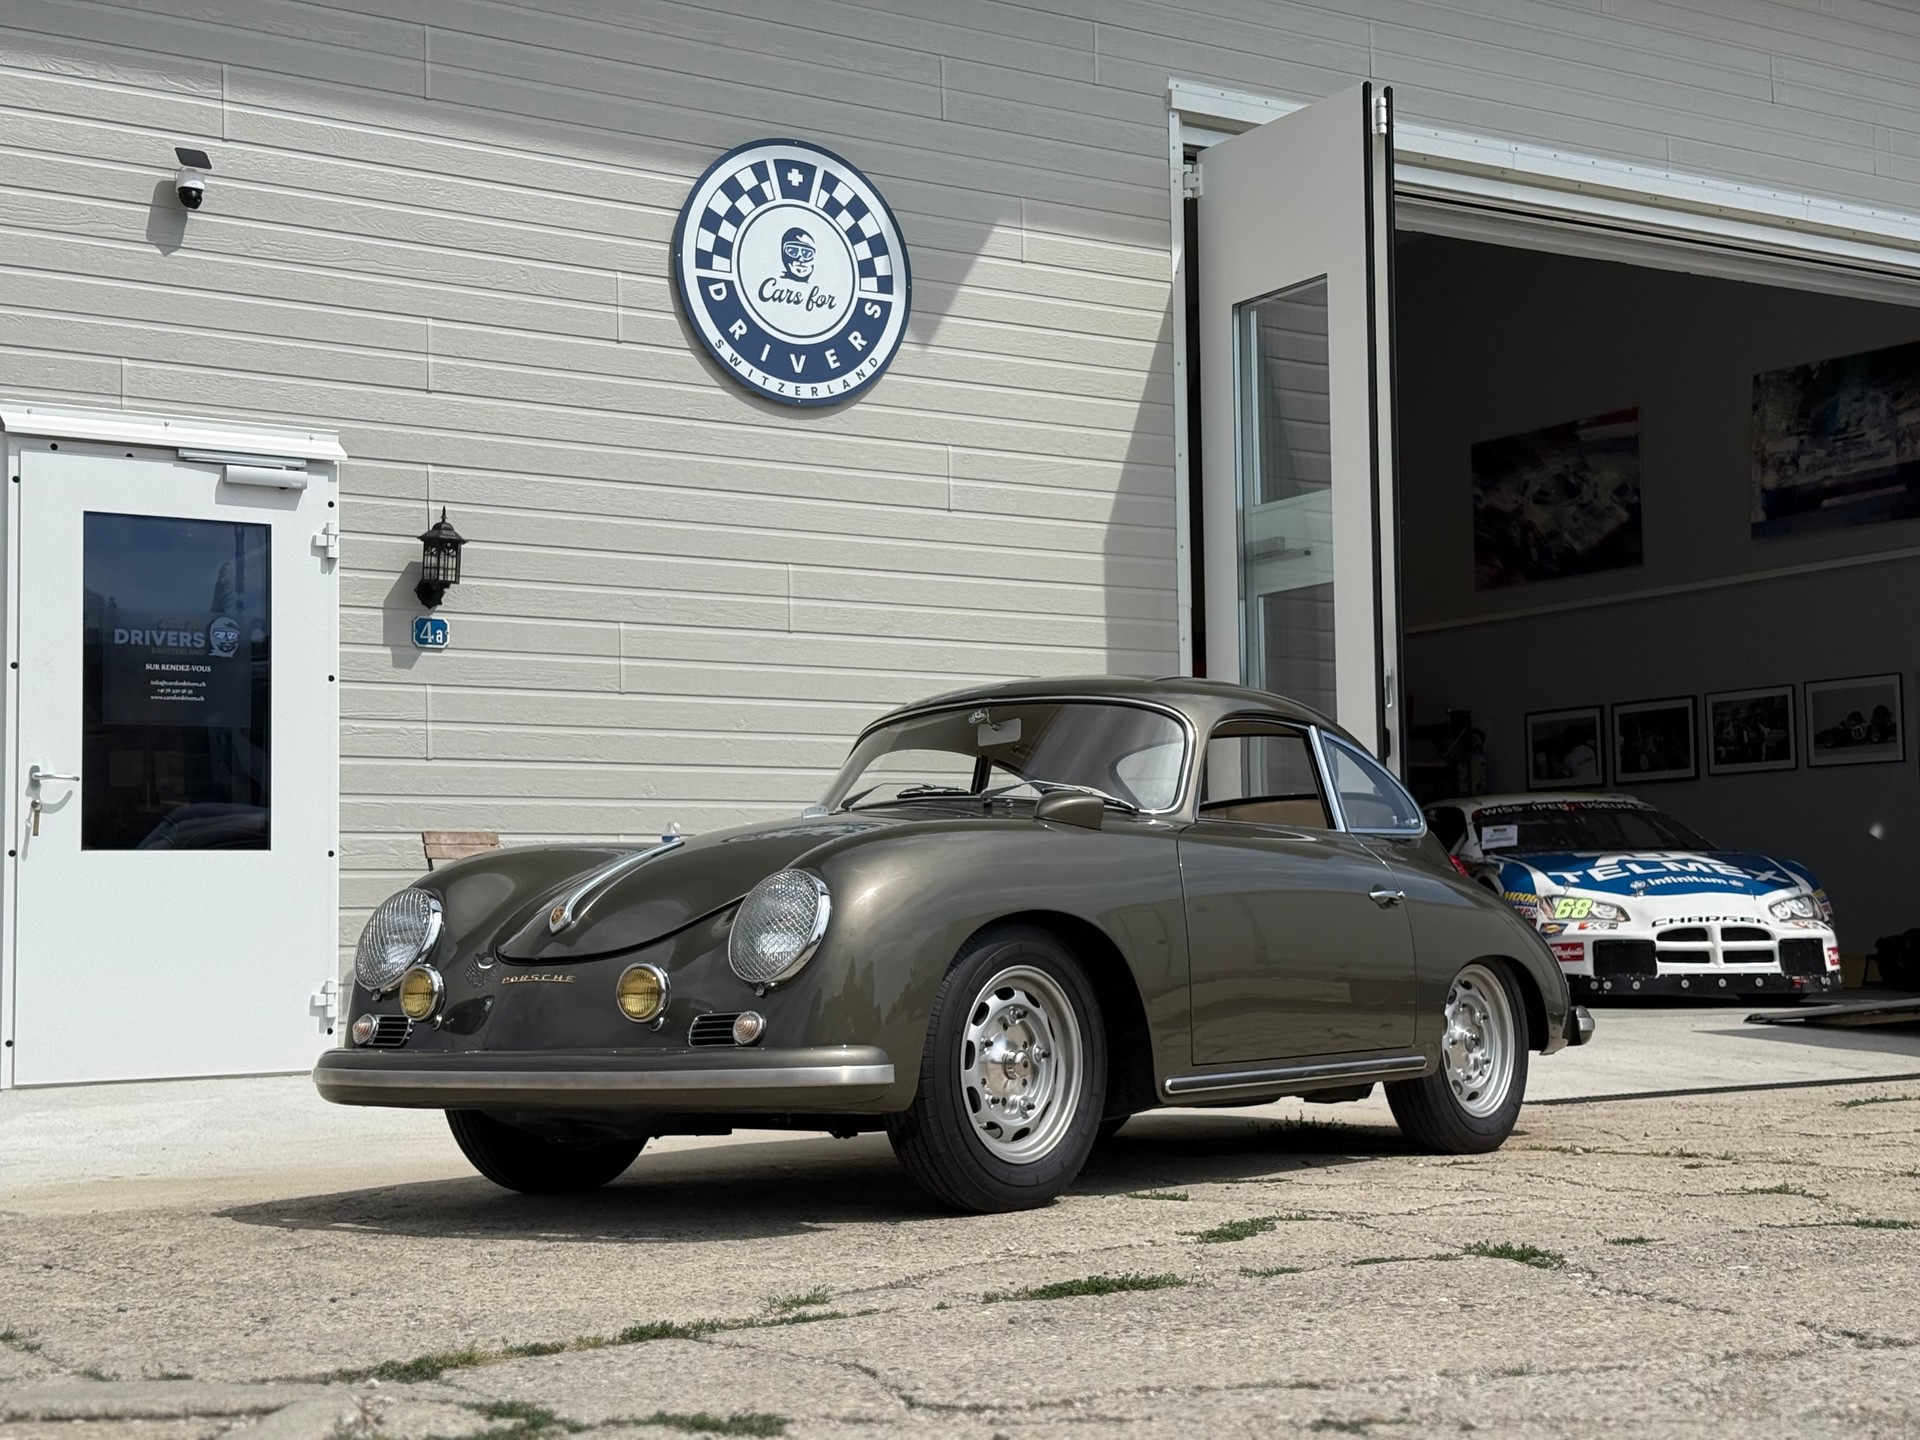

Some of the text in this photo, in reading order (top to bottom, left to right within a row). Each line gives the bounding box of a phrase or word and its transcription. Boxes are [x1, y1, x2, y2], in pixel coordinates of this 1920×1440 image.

[758, 277, 837, 312] Cars for
[708, 282, 882, 374] DRIVERS
[715, 338, 879, 397] SWITZERLAND
[114, 628, 206, 648] DRIVERS
[419, 621, 443, 643] 4a
[151, 647, 206, 656] SWITZERLAND
[145, 663, 212, 673] SUR RENDEZ-VOUS
[1547, 861, 1794, 884] TELMEX
[1647, 875, 1728, 886] infinitum
[1554, 898, 1592, 919] 68
[501, 974, 577, 985] PORSCHE
